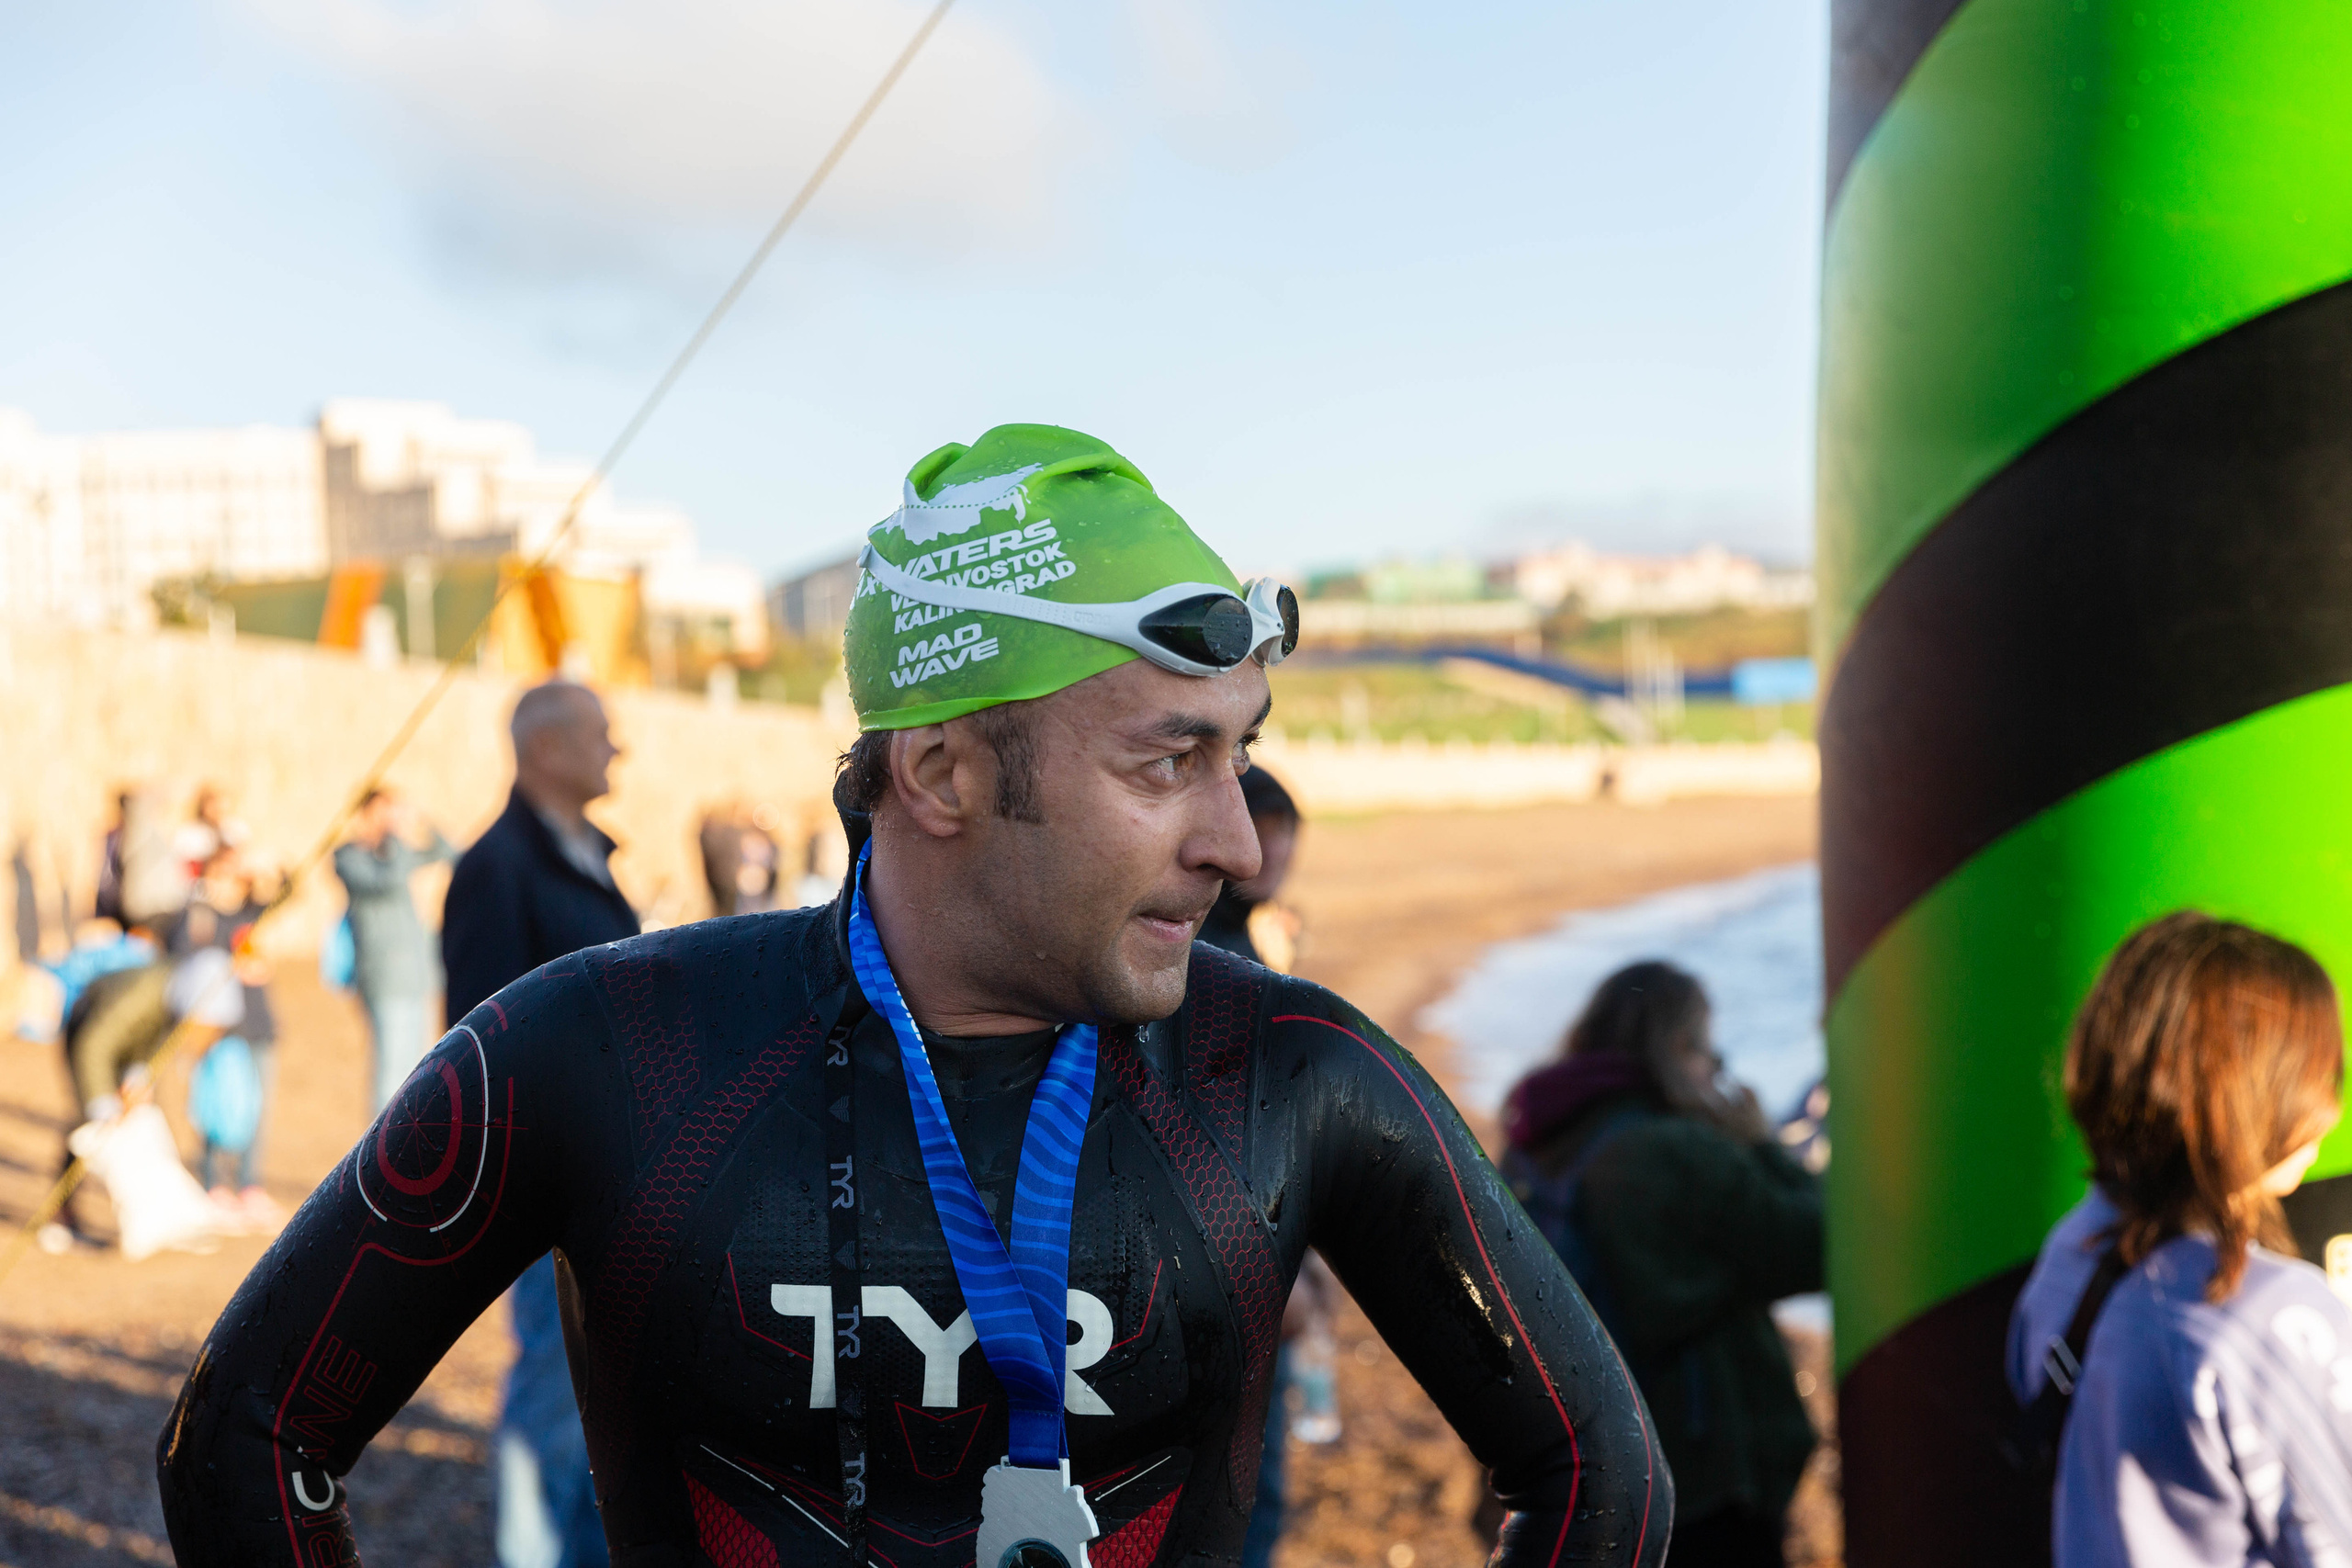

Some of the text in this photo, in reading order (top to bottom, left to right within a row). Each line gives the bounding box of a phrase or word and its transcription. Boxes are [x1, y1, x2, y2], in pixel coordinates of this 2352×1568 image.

[890, 541, 1067, 613] VLIVOSTOK
[889, 637, 999, 688] WAVE
[898, 623, 982, 666] MAD
[827, 1023, 855, 1066] TYR
[830, 1155, 854, 1210] TYR
[770, 1283, 1115, 1416] TYR
[837, 1304, 861, 1359] TYR
[841, 1452, 865, 1506] TYR
